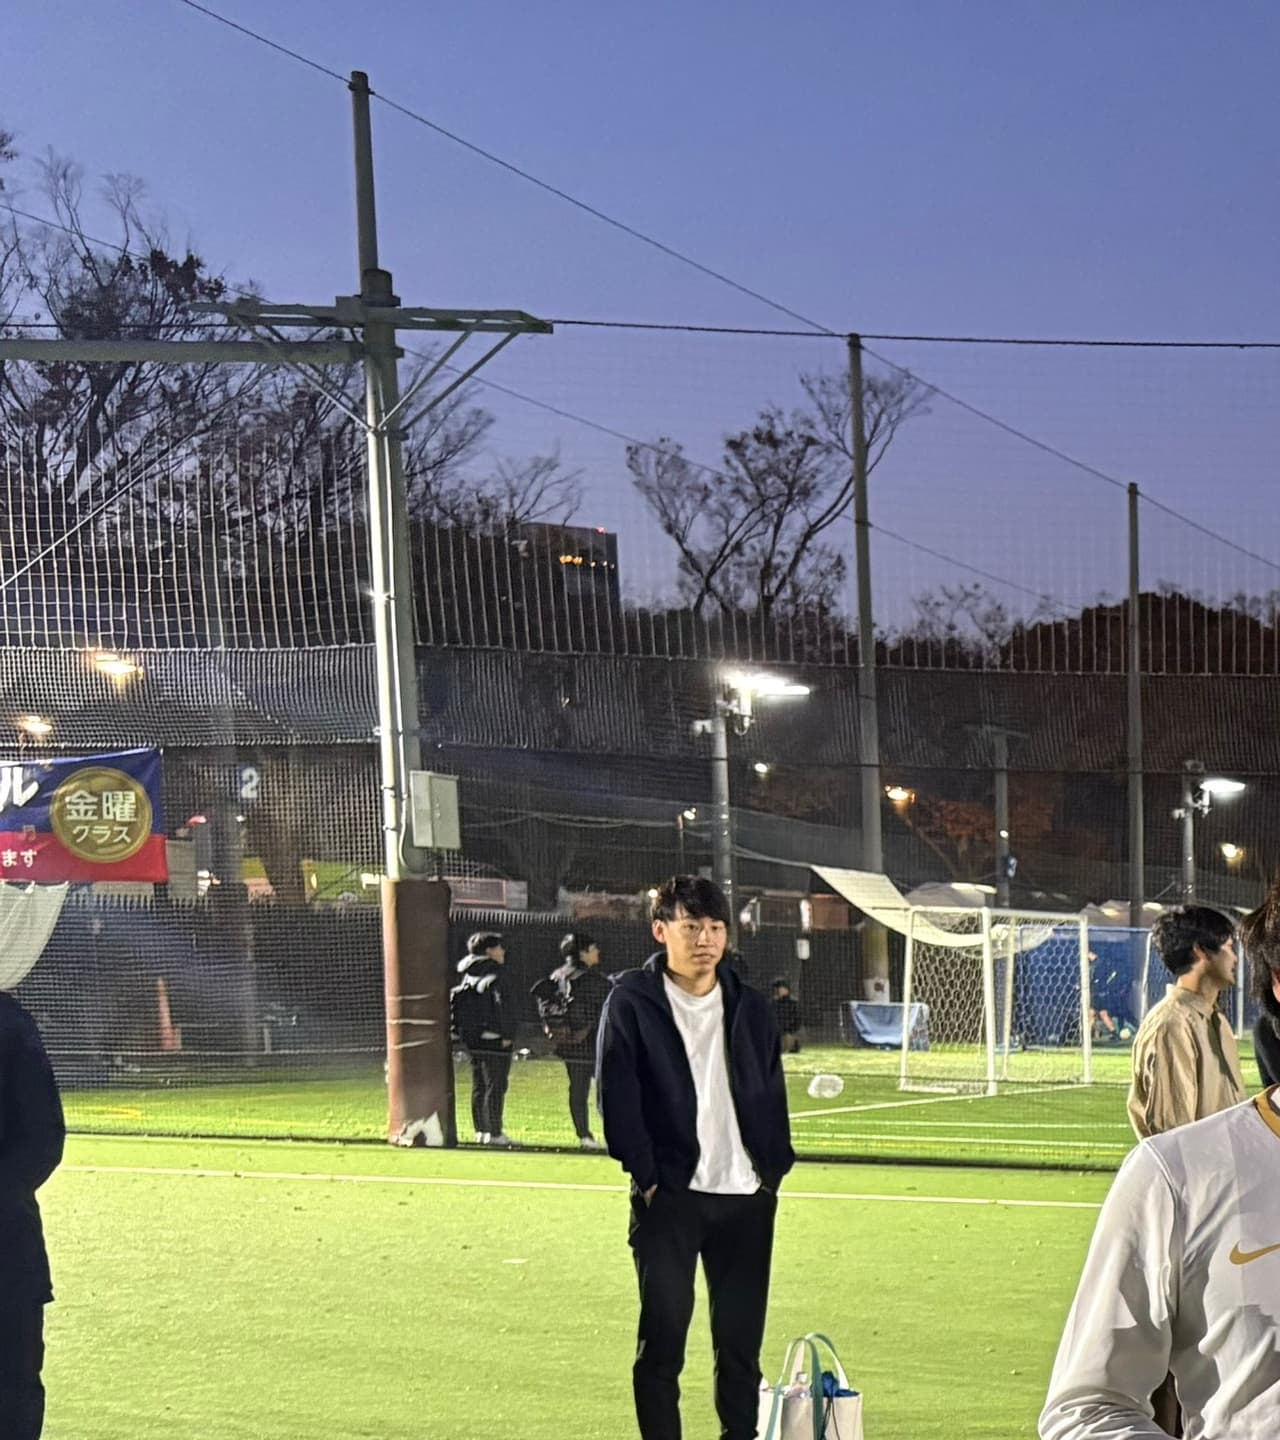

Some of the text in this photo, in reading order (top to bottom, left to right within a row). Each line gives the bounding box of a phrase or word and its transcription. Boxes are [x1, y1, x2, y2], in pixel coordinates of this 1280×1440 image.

[64, 789, 137, 822] 金曜
[72, 825, 131, 843] クラス
[2, 848, 37, 868] ます
